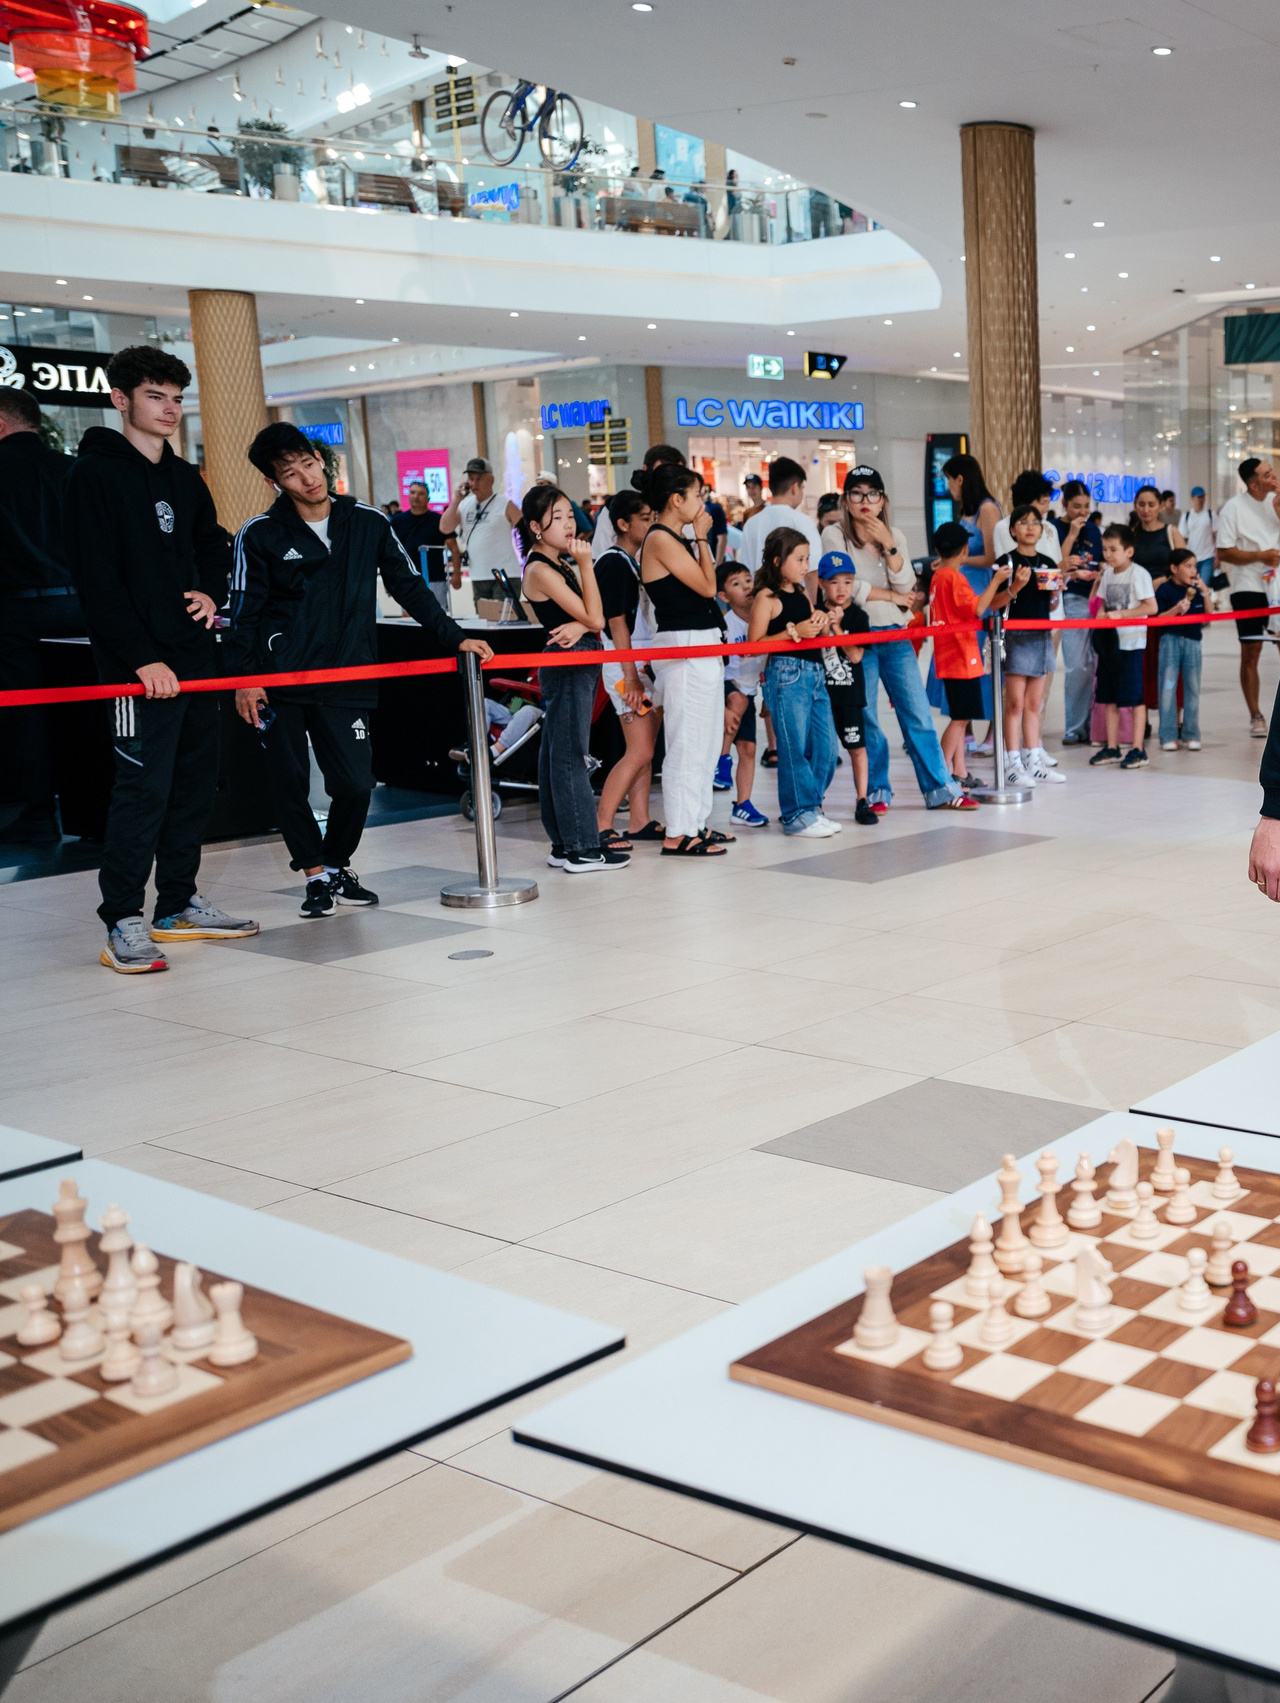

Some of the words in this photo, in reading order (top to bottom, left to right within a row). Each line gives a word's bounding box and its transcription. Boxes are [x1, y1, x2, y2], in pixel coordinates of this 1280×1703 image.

[677, 398, 724, 427] LC
[466, 511, 489, 522] E7
[355, 729, 365, 740] 10
